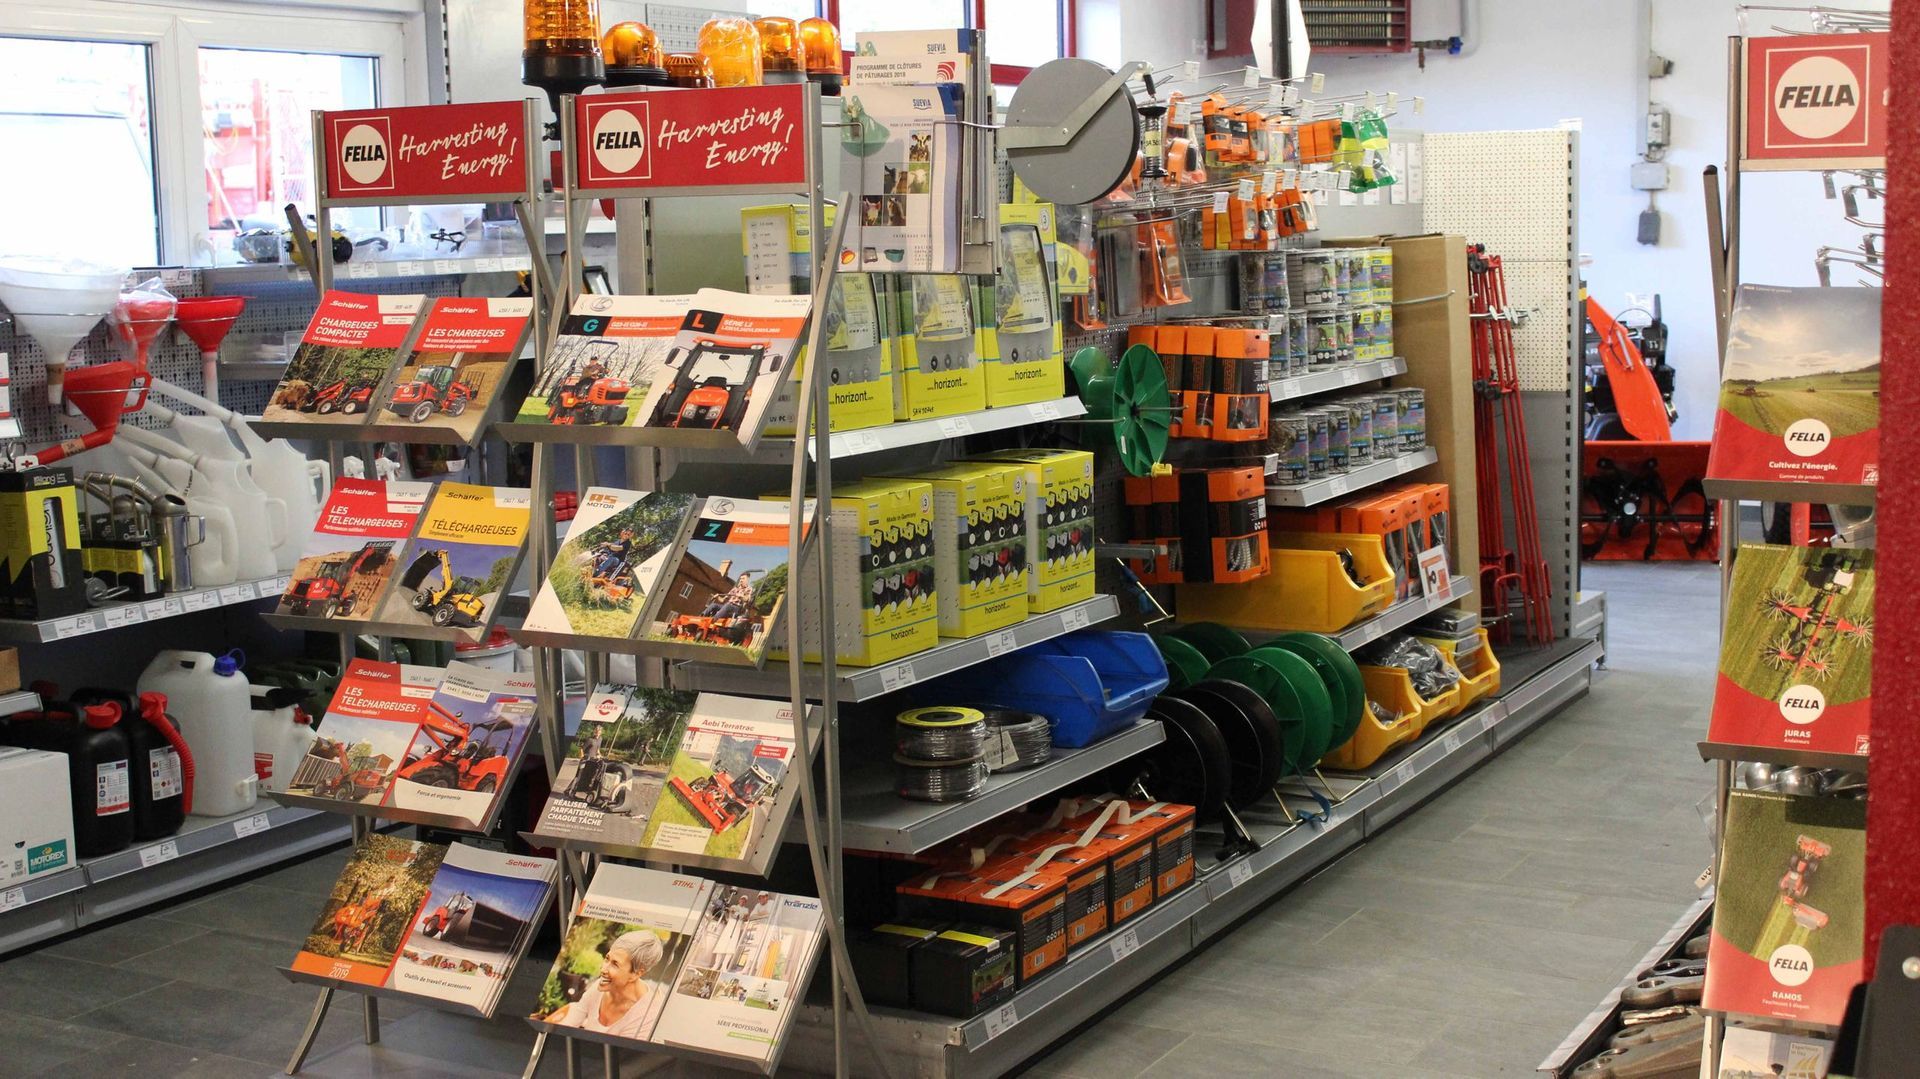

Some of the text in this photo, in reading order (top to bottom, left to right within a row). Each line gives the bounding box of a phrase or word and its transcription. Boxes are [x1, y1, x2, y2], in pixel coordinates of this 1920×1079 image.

[927, 43, 946, 52] SUEVIA
[1779, 84, 1855, 109] FELLA
[596, 107, 784, 150] FELLA Harvesting
[344, 122, 508, 162] FELLA Harvesting
[705, 124, 794, 169] Energy!
[441, 138, 517, 180] Energy!
[330, 300, 368, 309] Schäffer
[320, 317, 379, 329] CHARGEUSES
[584, 318, 598, 332] G
[692, 313, 705, 329] L
[316, 326, 369, 338] COMPACTES
[428, 328, 506, 337] LES CHARGEUSES
[1789, 432, 1825, 443] FELLA
[1802, 462, 1838, 471] l'énergie.
[340, 488, 376, 496] Schäffer
[331, 505, 348, 515] LES
[327, 515, 403, 528] TELECHARGEUSES
[432, 518, 518, 536] TÉLÉCHARGEUSES
[704, 523, 721, 537] Z
[354, 669, 392, 679] Schäffer
[504, 680, 536, 688] Schäff
[345, 686, 363, 696] LES
[342, 696, 416, 712] TELECHARGEUSES
[1785, 699, 1820, 710] FELLA
[721, 722, 755, 731] Terratrac
[1784, 729, 1811, 738] JURAS
[553, 798, 588, 808] RÉALISER
[550, 806, 605, 818] PARFAITEMENT
[548, 814, 602, 826] CHAQUE TÂCHE
[30, 850, 65, 866] MOTOREX
[506, 859, 542, 868] Schäffer
[672, 880, 693, 888] STIHL
[1774, 958, 1808, 972] FELLA
[329, 966, 350, 979] 2019
[404, 972, 418, 980] Outils
[426, 977, 441, 985] travail
[447, 982, 472, 990] accessoires
[1772, 991, 1802, 1002] RAMOS
[731, 1022, 769, 1034] PROFESSIONAL
